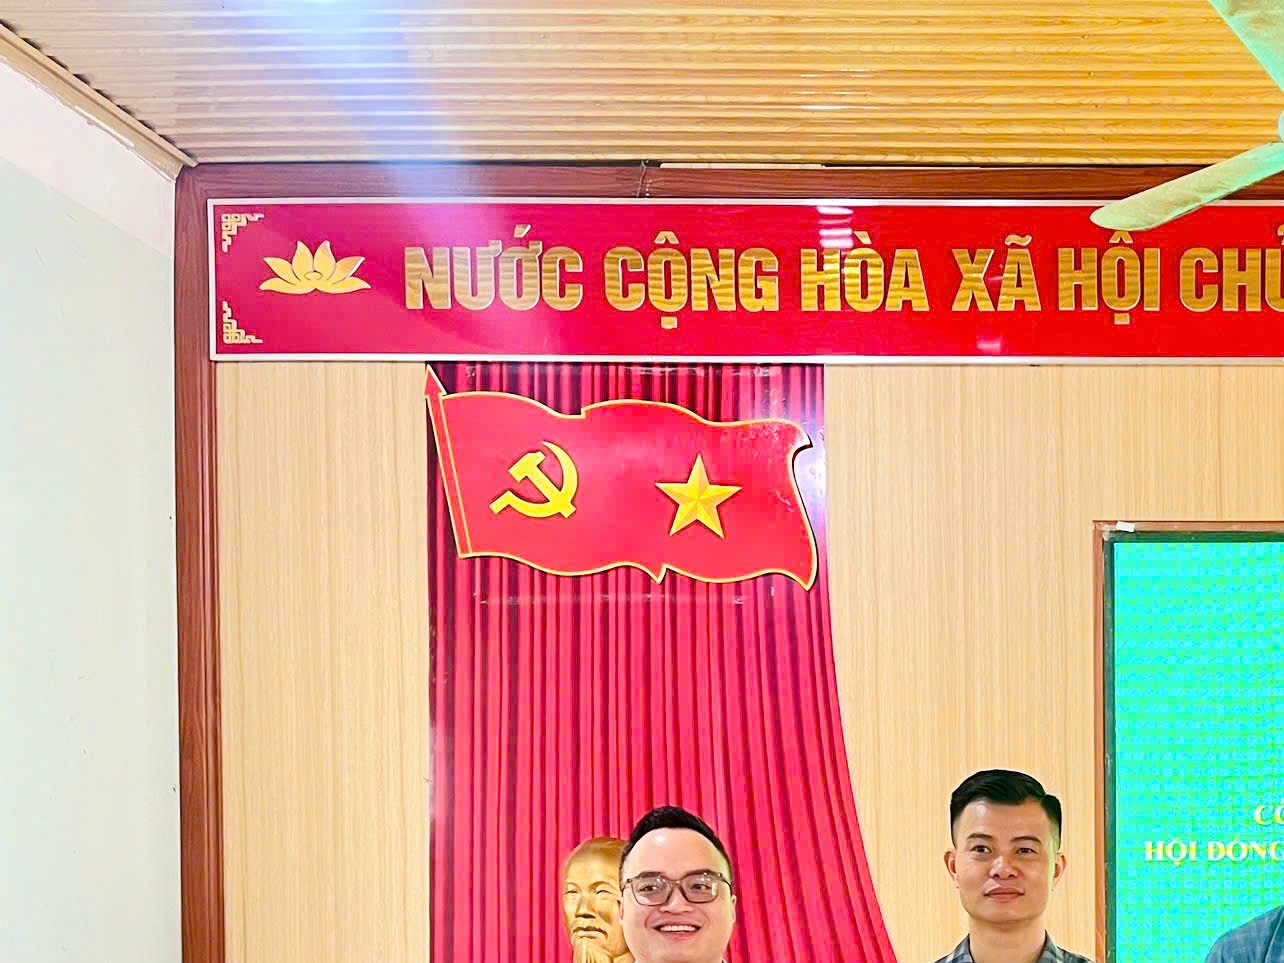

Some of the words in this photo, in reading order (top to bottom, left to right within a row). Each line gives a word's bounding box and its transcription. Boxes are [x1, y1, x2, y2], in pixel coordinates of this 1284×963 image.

[405, 225, 583, 311] NƯỚC
[604, 231, 780, 329] CỘNG
[803, 231, 928, 312] HÒA
[951, 234, 1042, 312] XÃ
[1058, 230, 1161, 324] HỘI
